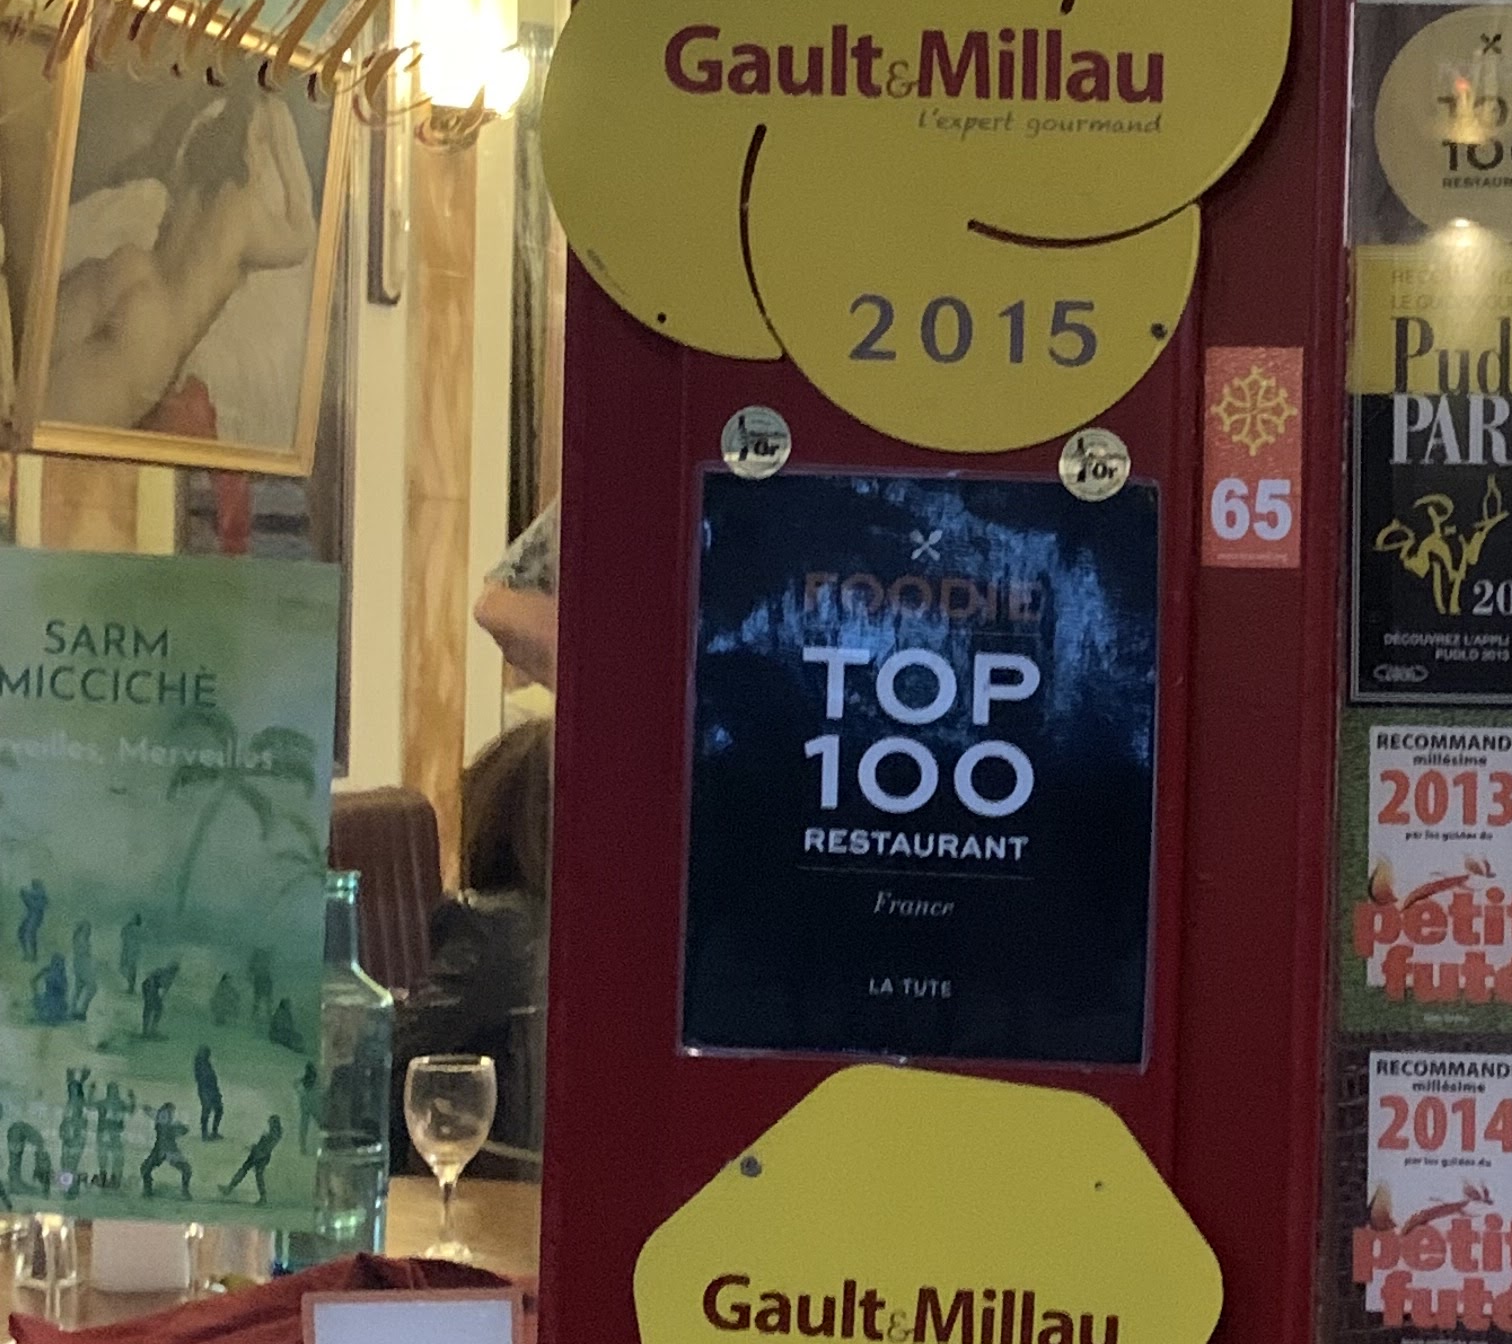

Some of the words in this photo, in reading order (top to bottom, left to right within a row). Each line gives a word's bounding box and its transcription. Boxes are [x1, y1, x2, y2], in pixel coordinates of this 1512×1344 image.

[664, 23, 1165, 105] Gault&Millau
[1026, 111, 1162, 139] gourmand
[848, 293, 1099, 367] 2015
[1211, 477, 1293, 542] 65
[803, 570, 1043, 623] FOODIE
[44, 619, 169, 657] SARM
[802, 646, 1041, 726] TOP
[804, 733, 1035, 818] 100
[803, 827, 1030, 862] RESTAURANT
[872, 890, 956, 918] France
[868, 978, 894, 996] LA
[901, 978, 954, 999] TUTE
[1411, 1079, 1486, 1094] millésime
